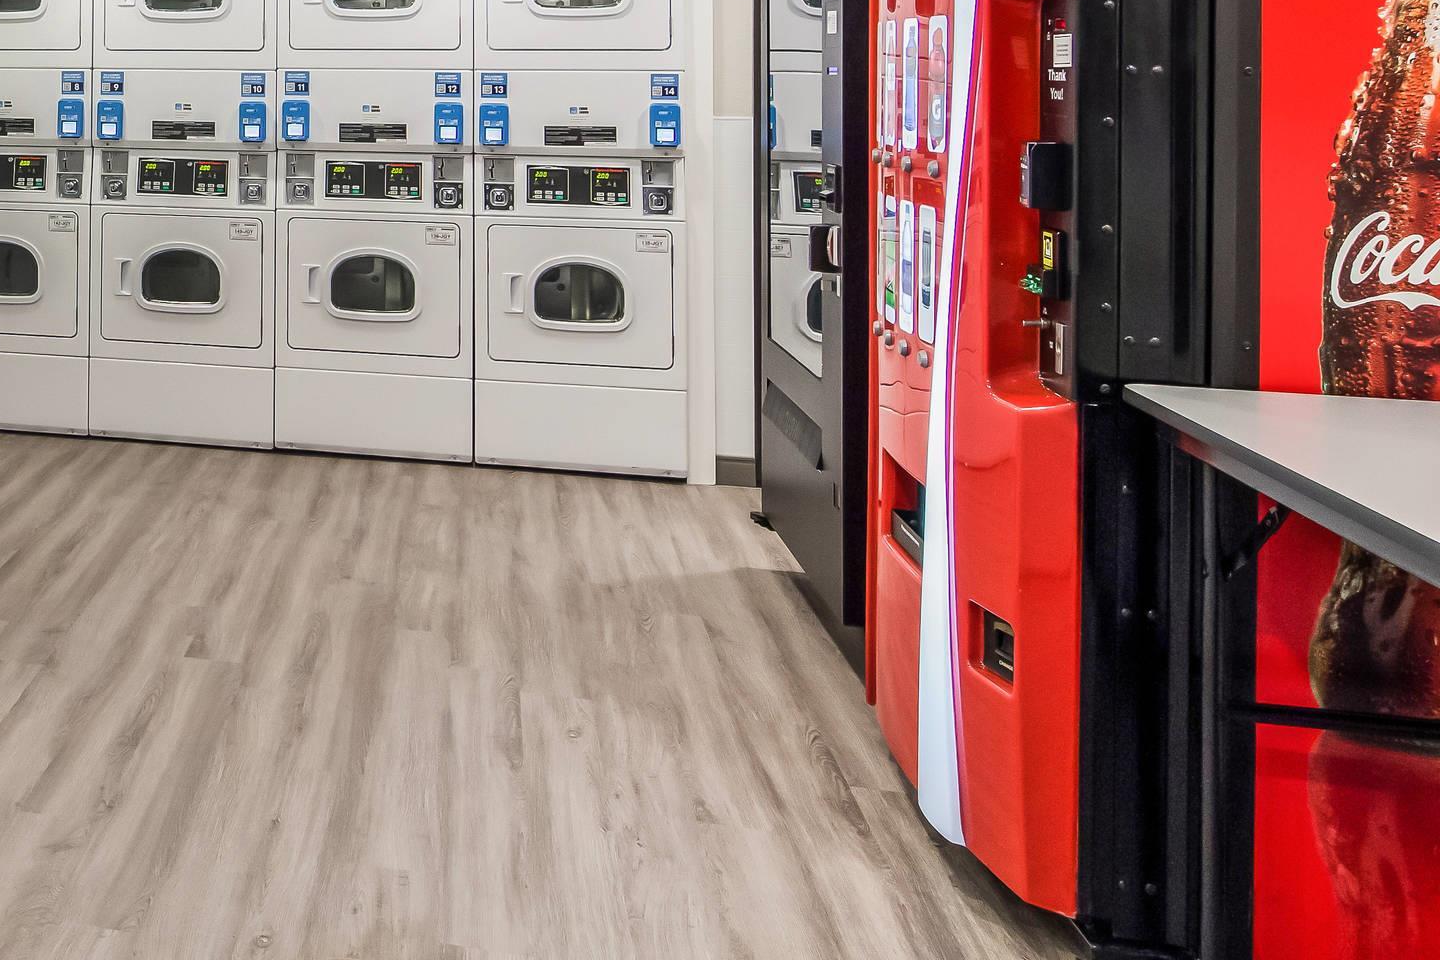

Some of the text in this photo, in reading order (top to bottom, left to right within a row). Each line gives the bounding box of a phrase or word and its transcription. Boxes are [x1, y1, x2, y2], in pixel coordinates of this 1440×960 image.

[1048, 69, 1067, 82] Thank
[253, 85, 263, 93] 10
[297, 83, 305, 91] 11
[448, 85, 457, 93] 12
[494, 85, 504, 94] 13
[664, 87, 675, 95] 14
[1050, 87, 1064, 100] You!
